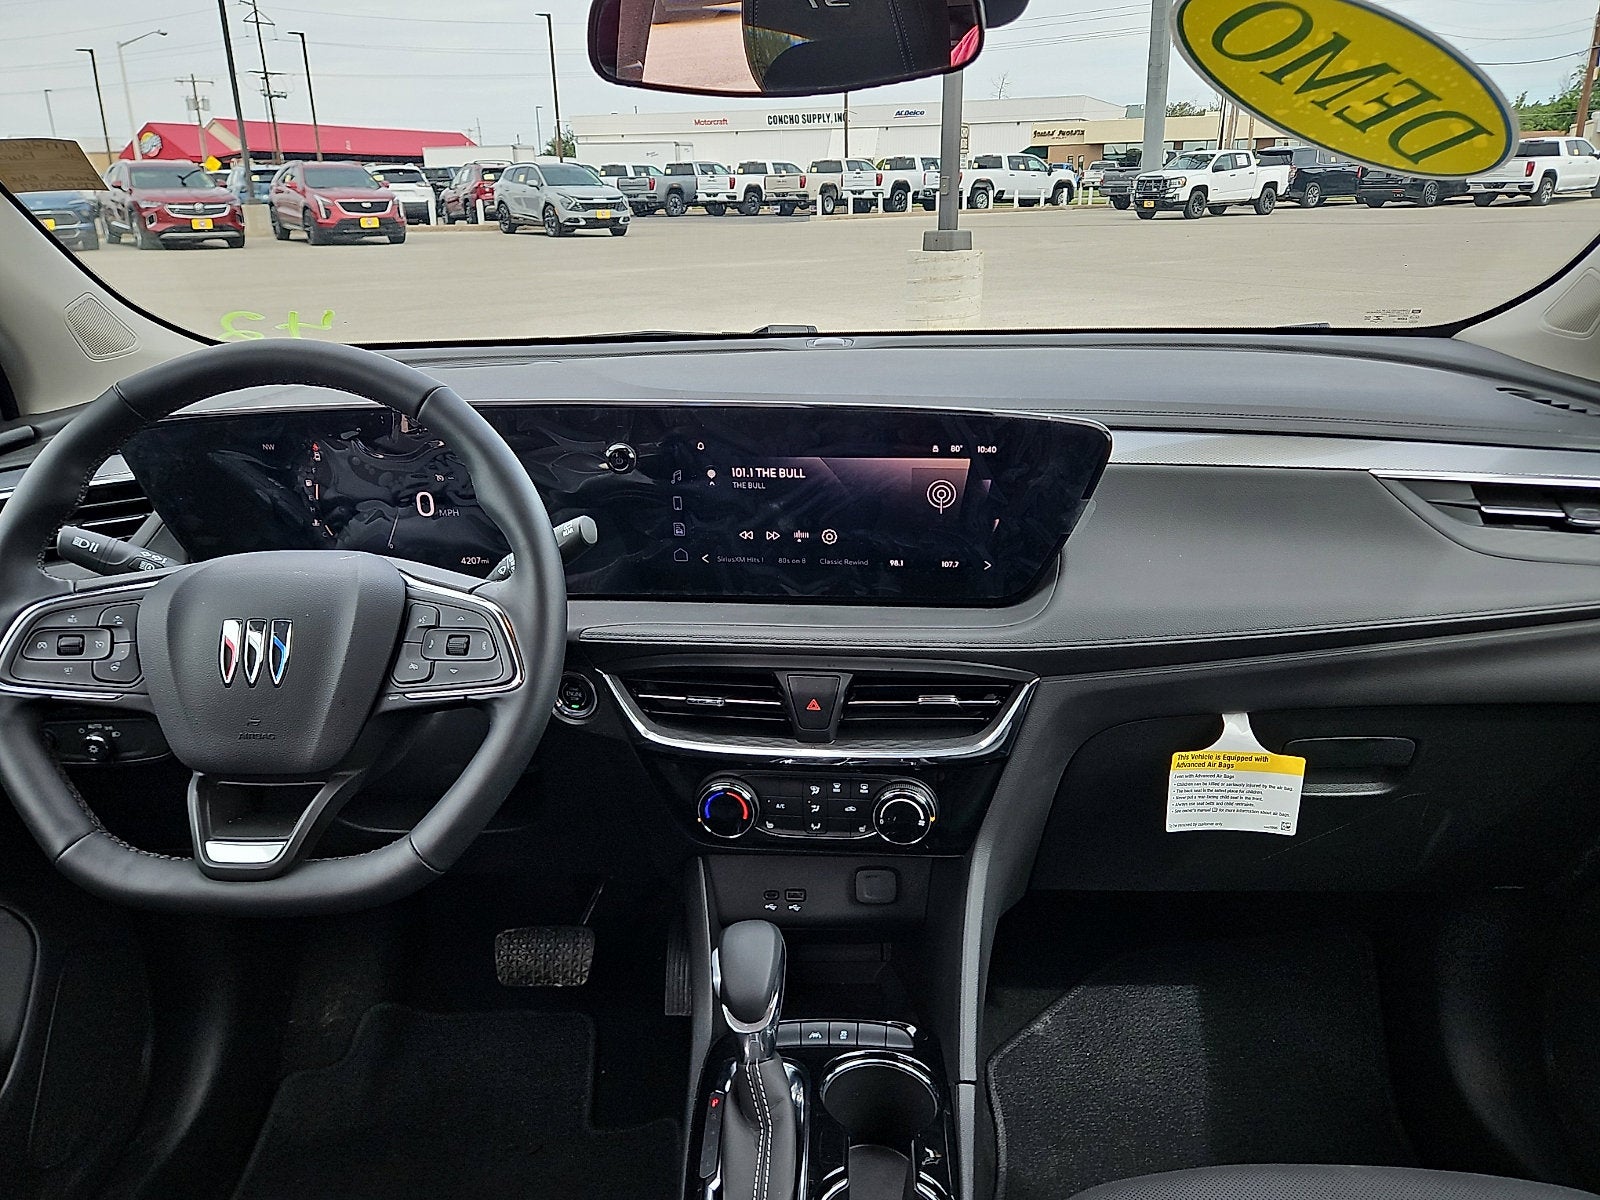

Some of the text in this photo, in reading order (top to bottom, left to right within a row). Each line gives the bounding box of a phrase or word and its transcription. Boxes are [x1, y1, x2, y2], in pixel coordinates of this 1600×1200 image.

[694, 118, 728, 126] Motorcraft
[767, 114, 800, 126] CONCHO
[801, 113, 833, 125] SUPPLY,
[262, 443, 276, 451] NW
[977, 445, 998, 454] 10:40
[731, 467, 807, 479] 101.1 THE BULL
[732, 481, 767, 490] THE BULL
[415, 491, 460, 518] 0 MPH
[716, 555, 746, 564] SiriusXM
[819, 558, 869, 567] Classic Rewind
[889, 559, 904, 567] 98.1
[941, 560, 960, 569] 107.7
[1222, 754, 1253, 762] Equipped
[1176, 761, 1206, 769] Advanced
[1218, 761, 1235, 770] Bags
